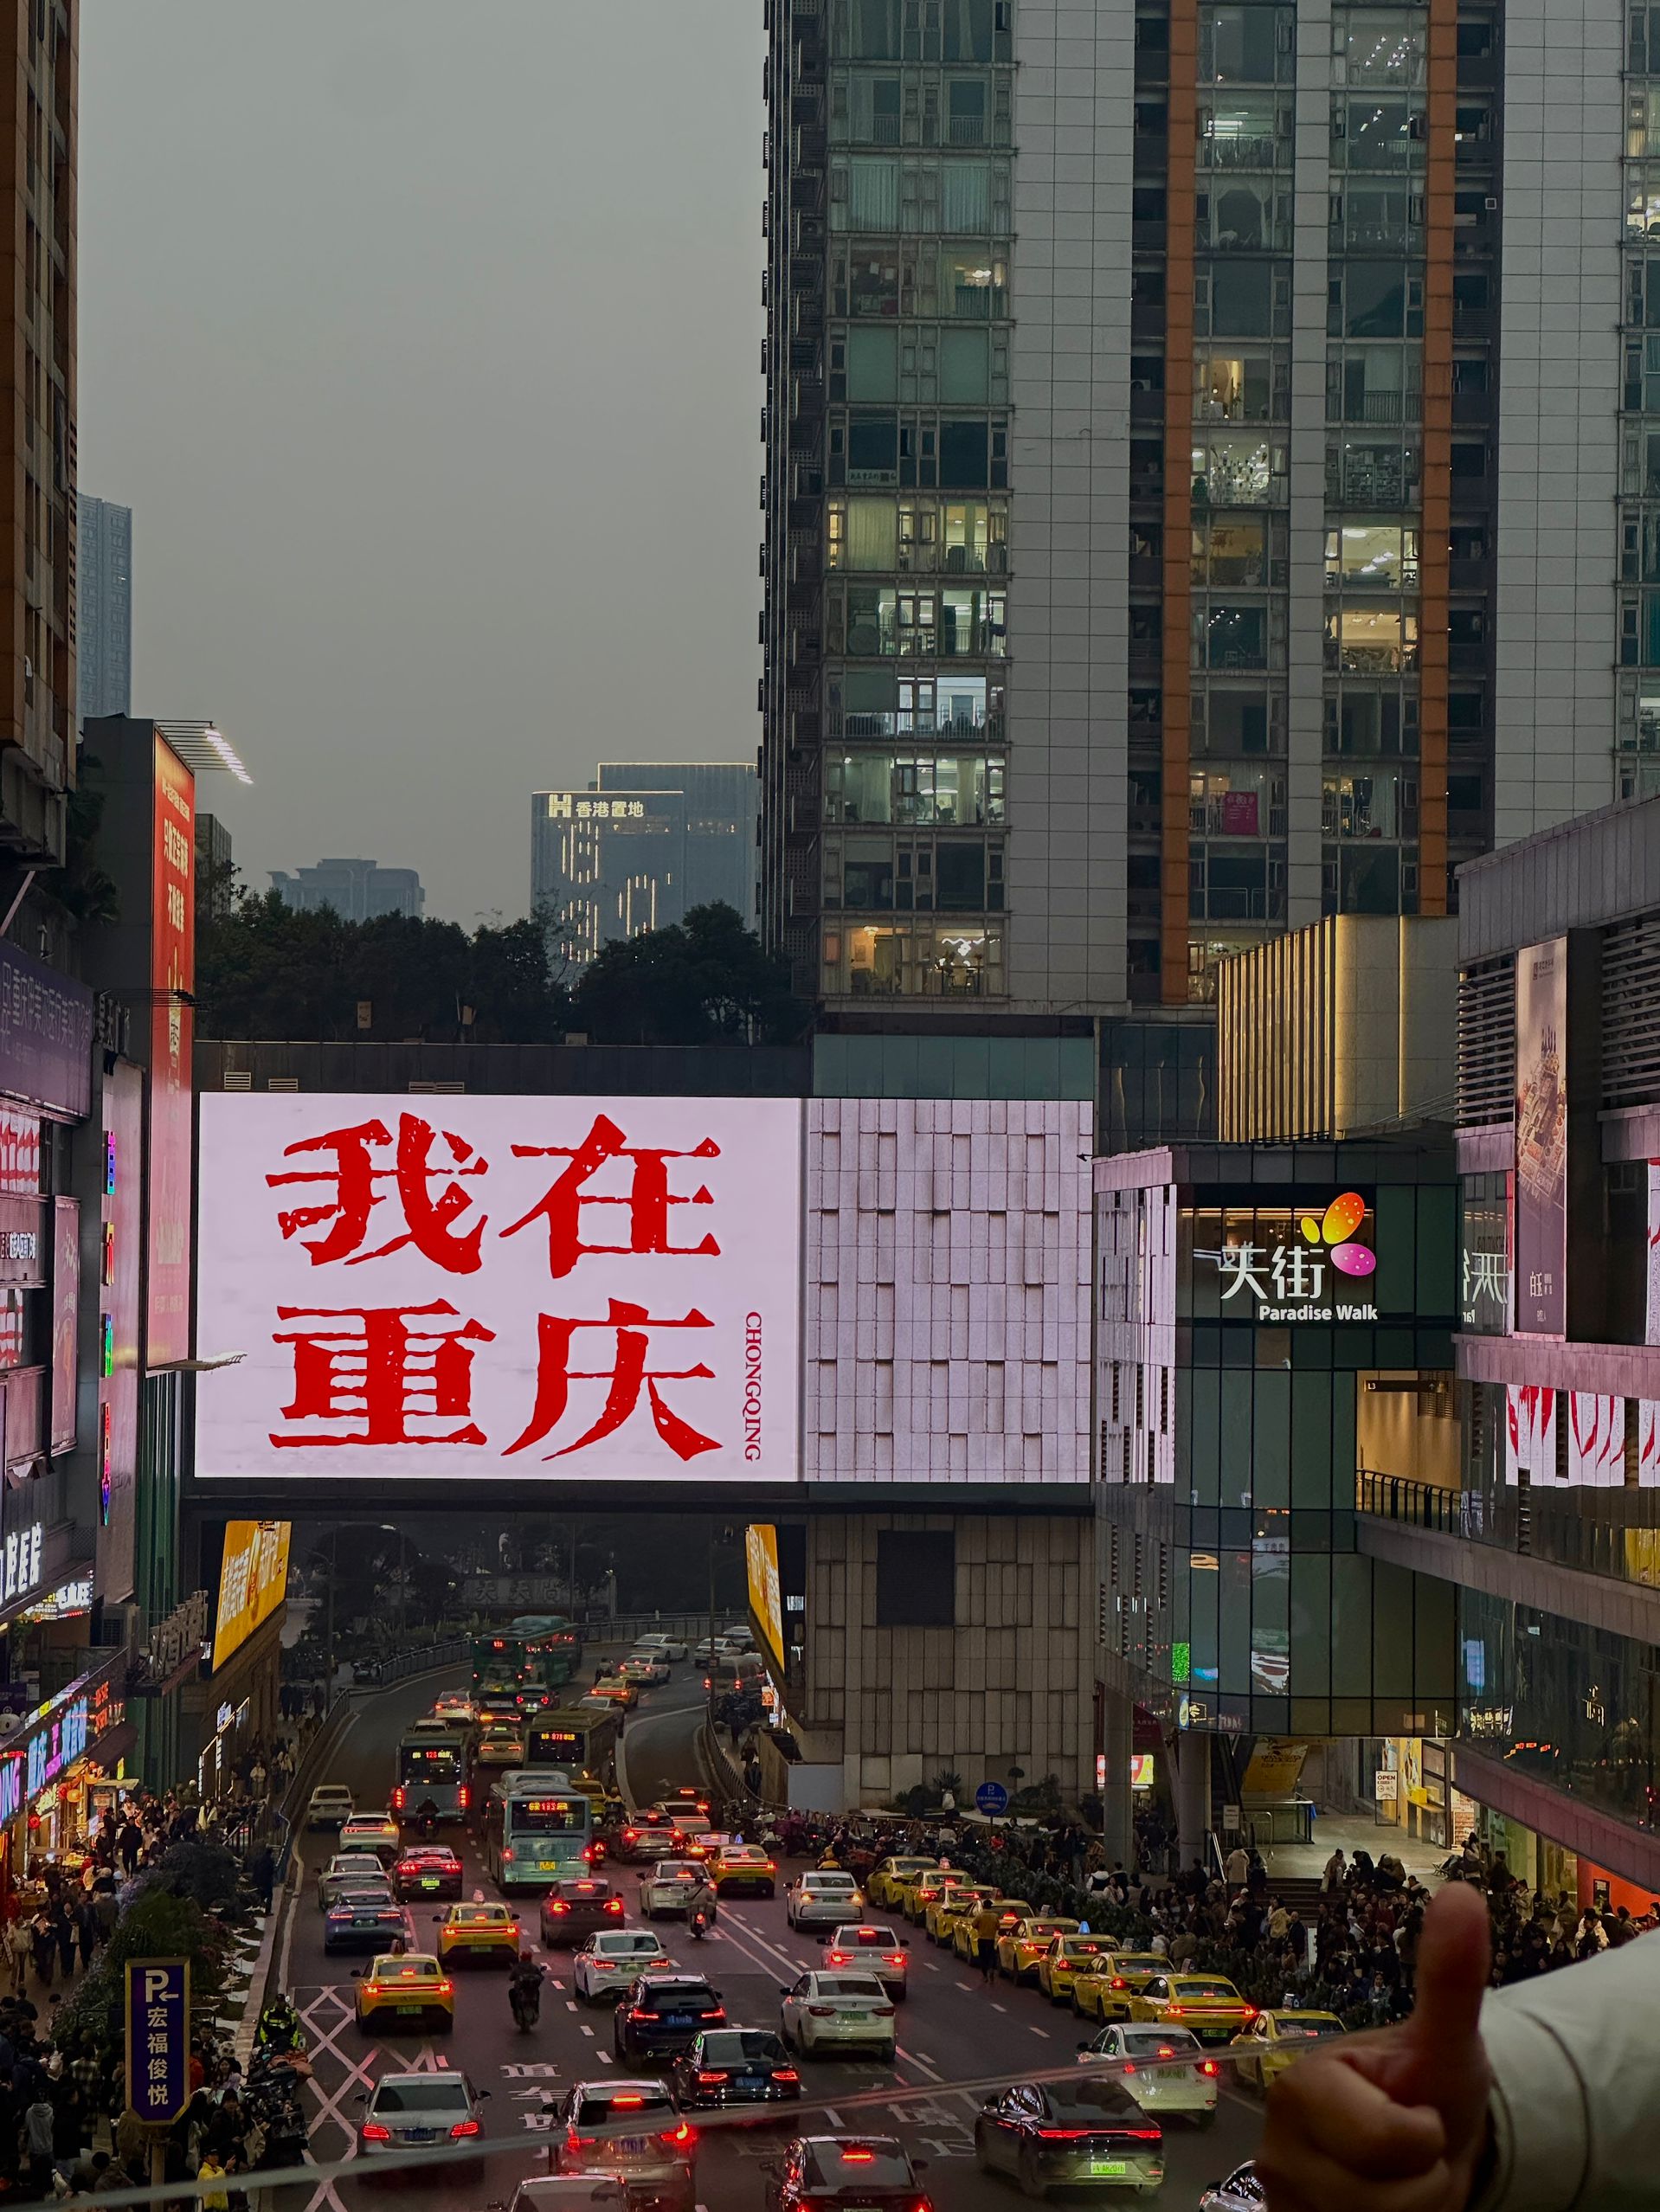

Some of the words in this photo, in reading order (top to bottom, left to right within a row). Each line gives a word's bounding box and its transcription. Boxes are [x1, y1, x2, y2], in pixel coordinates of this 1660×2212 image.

[576, 801, 644, 818] 香港置地
[266, 1112, 721, 1279] 我在
[1219, 1245, 1326, 1300] 天街
[1259, 1305, 1332, 1321] Paradise
[1336, 1303, 1379, 1321] Walk
[268, 1297, 724, 1461] 重庆
[744, 1311, 762, 1462] CHONGQING
[145, 1970, 170, 2003] P
[147, 2006, 169, 2106] 宏福俊悦
